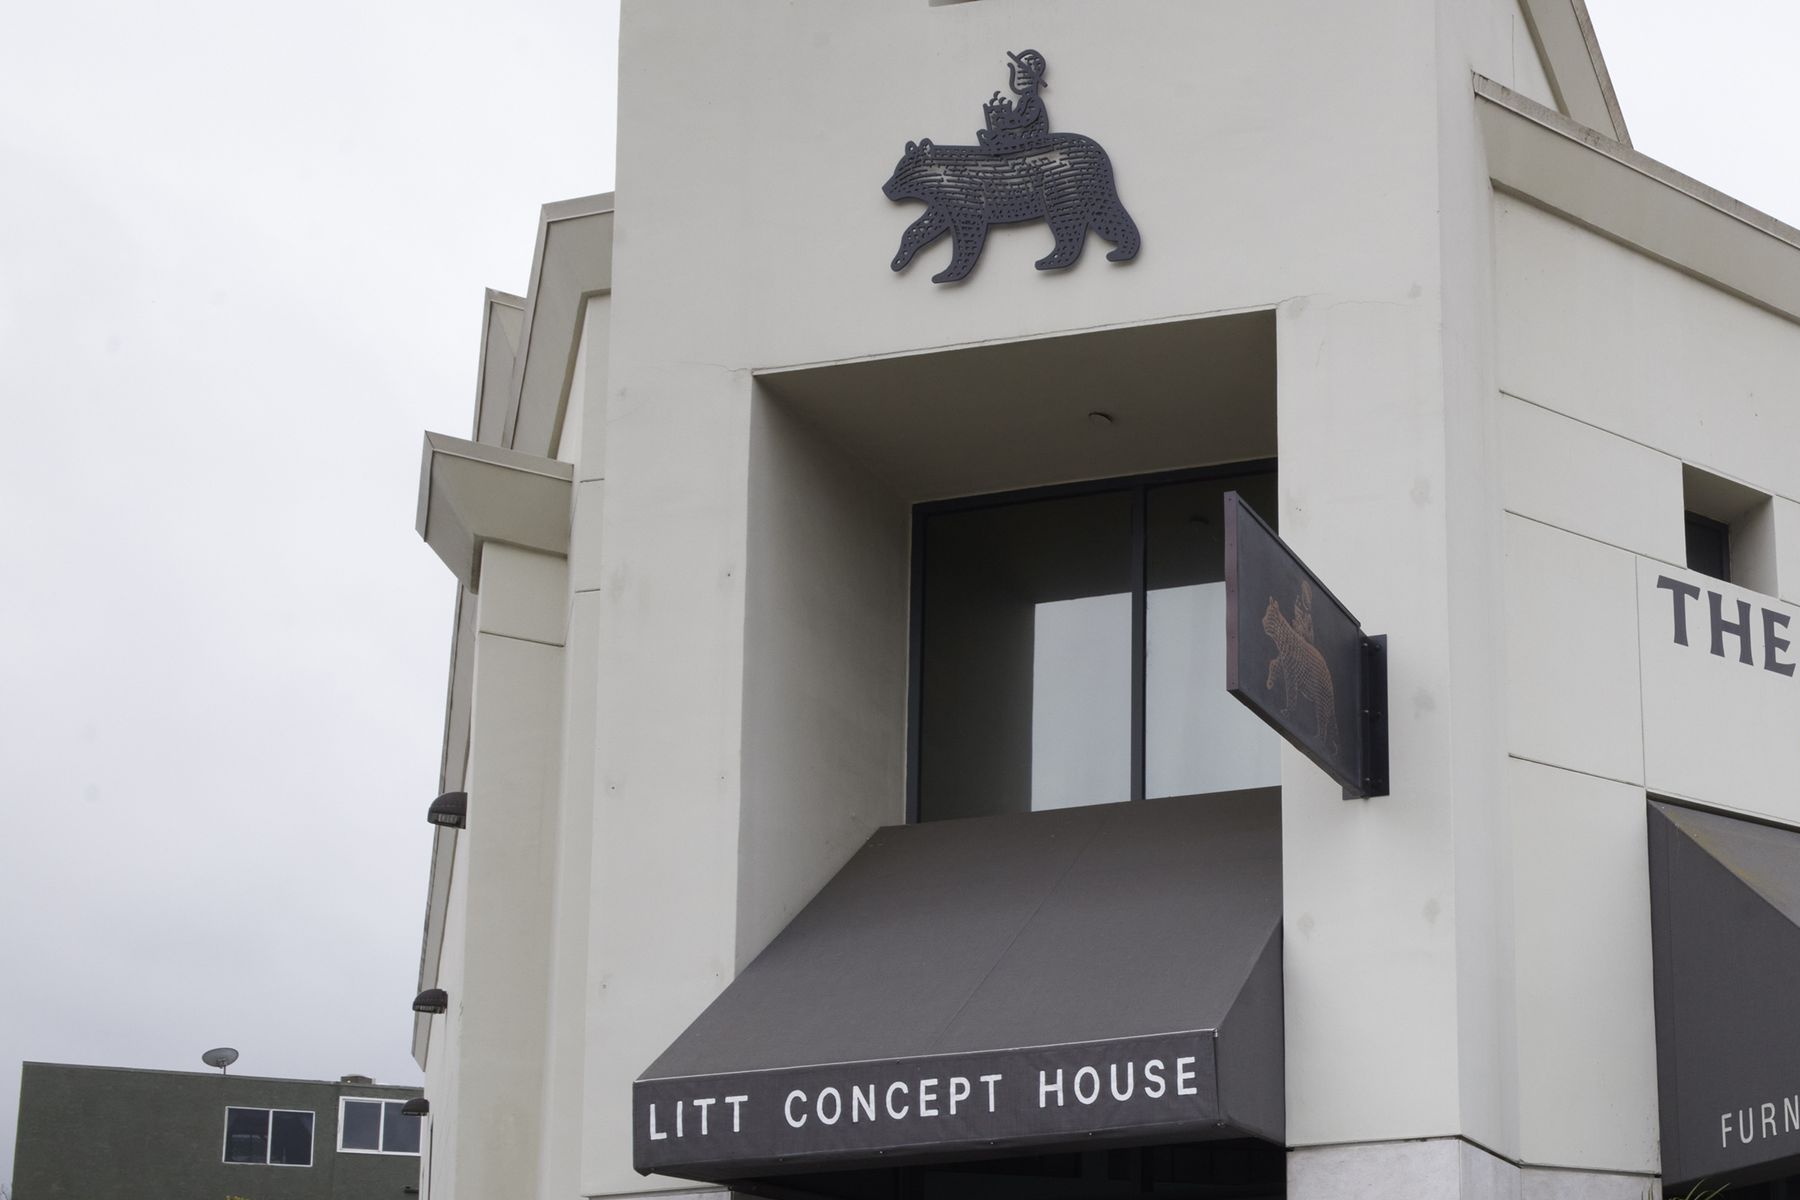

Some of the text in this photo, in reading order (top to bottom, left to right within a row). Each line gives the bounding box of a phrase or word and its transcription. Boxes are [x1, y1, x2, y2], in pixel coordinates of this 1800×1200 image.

[1657, 575, 1796, 677] THE
[650, 1056, 1197, 1140] LITT CONCEPT HOUSE
